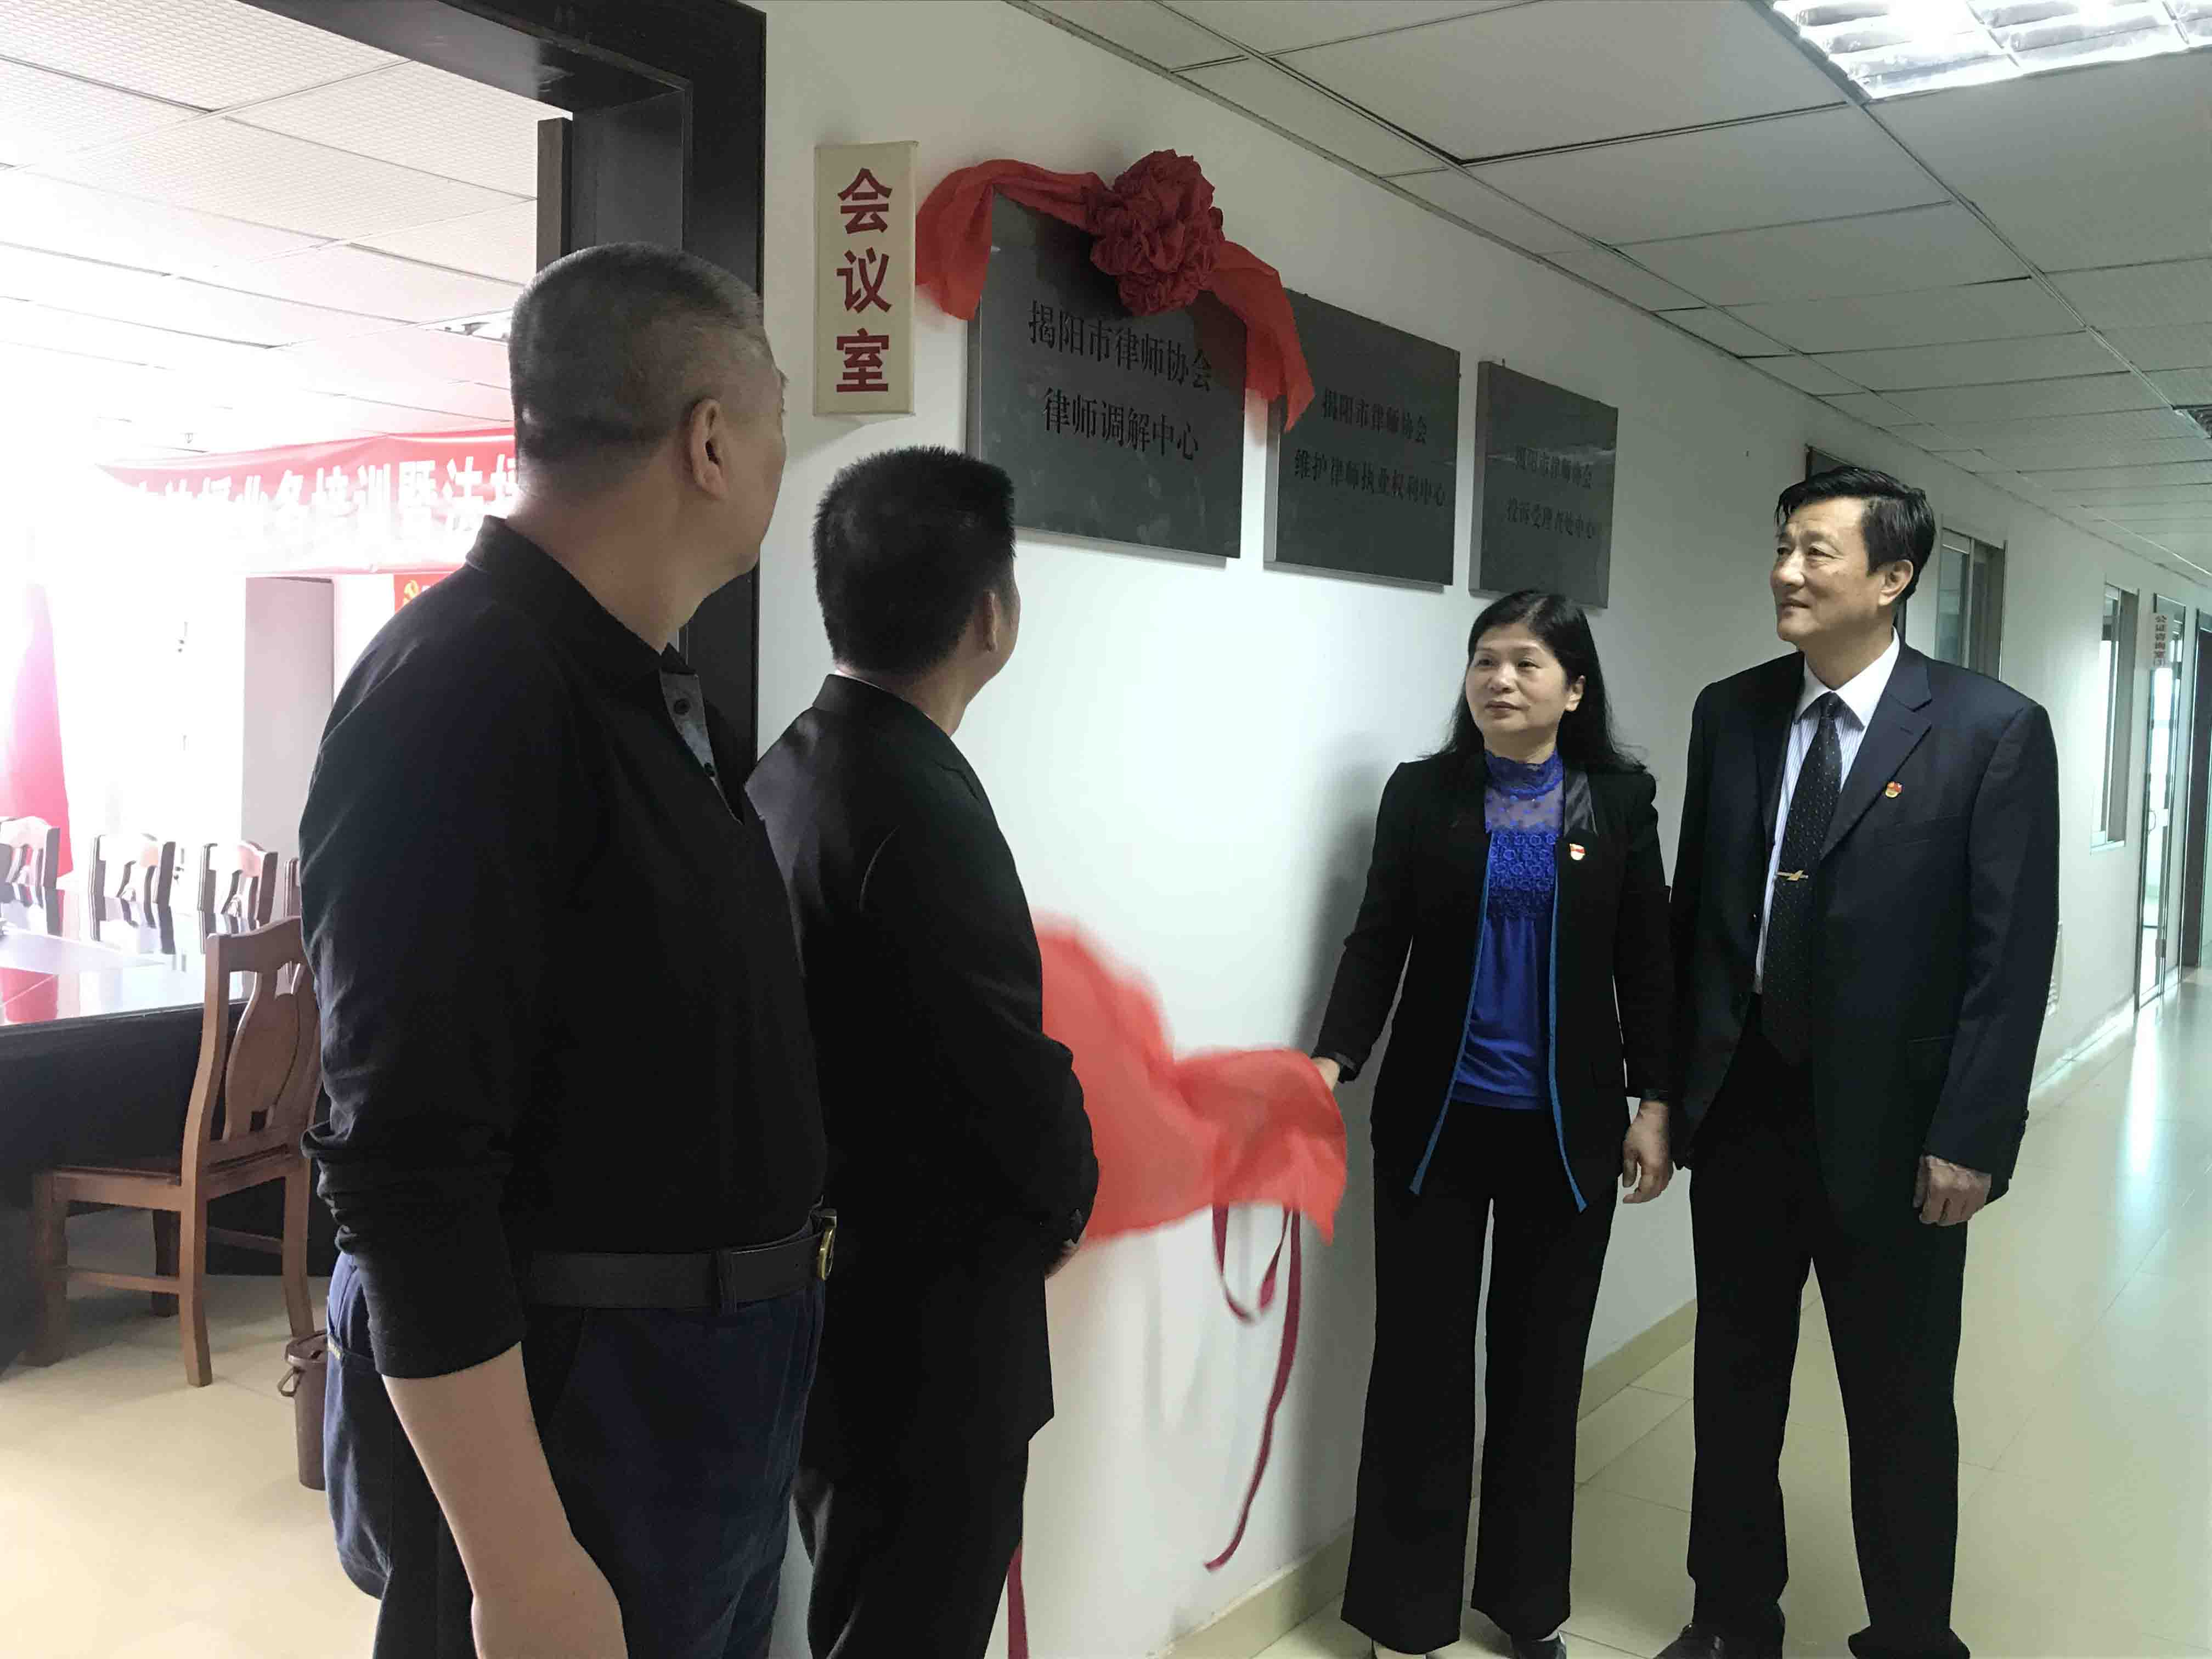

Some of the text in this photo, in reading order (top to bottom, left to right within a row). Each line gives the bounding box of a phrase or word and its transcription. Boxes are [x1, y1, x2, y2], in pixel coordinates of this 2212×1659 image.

[836, 167, 893, 393] 会议室
[1028, 300, 1212, 392] 揭阳市律师协会
[1042, 386, 1199, 461] 律师调解中心
[1321, 387, 1427, 444] 揭阳市律师协会
